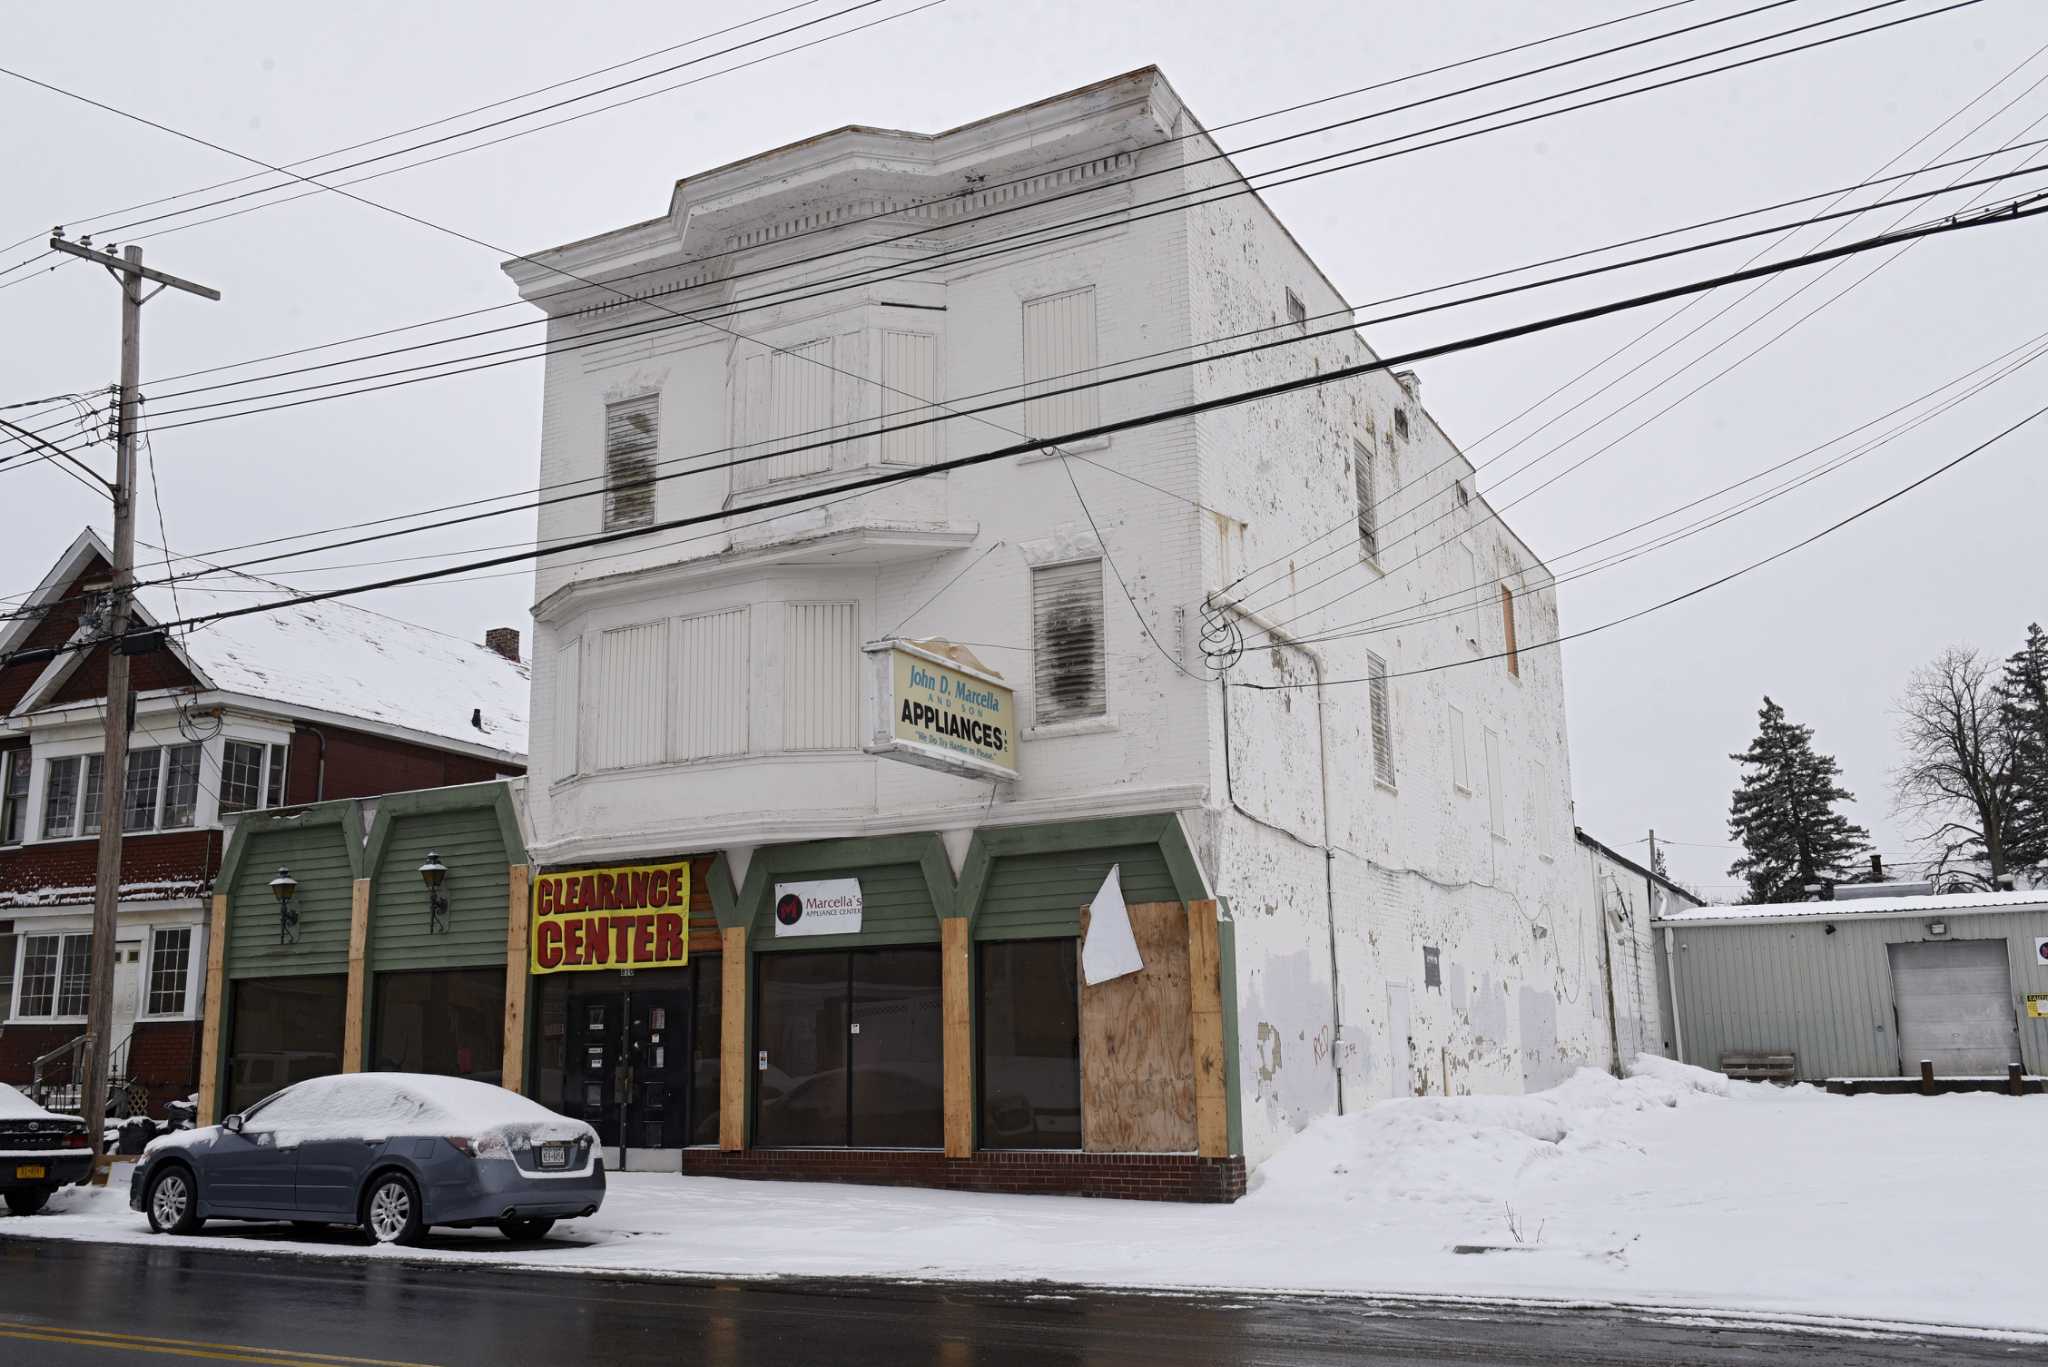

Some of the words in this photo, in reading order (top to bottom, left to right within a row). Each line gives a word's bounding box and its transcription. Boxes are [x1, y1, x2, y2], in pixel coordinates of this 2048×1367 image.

[910, 665, 935, 690] John
[940, 675, 951, 696] D.
[955, 681, 999, 712] Marcella
[928, 693, 951, 707] AND
[961, 704, 983, 717] SON
[901, 698, 1003, 751] APPLIANCES
[538, 868, 683, 916] CLEARANCE
[805, 909, 838, 917] APPLIANCE
[806, 896, 863, 909] Marcella's
[537, 913, 683, 969] CENTER
